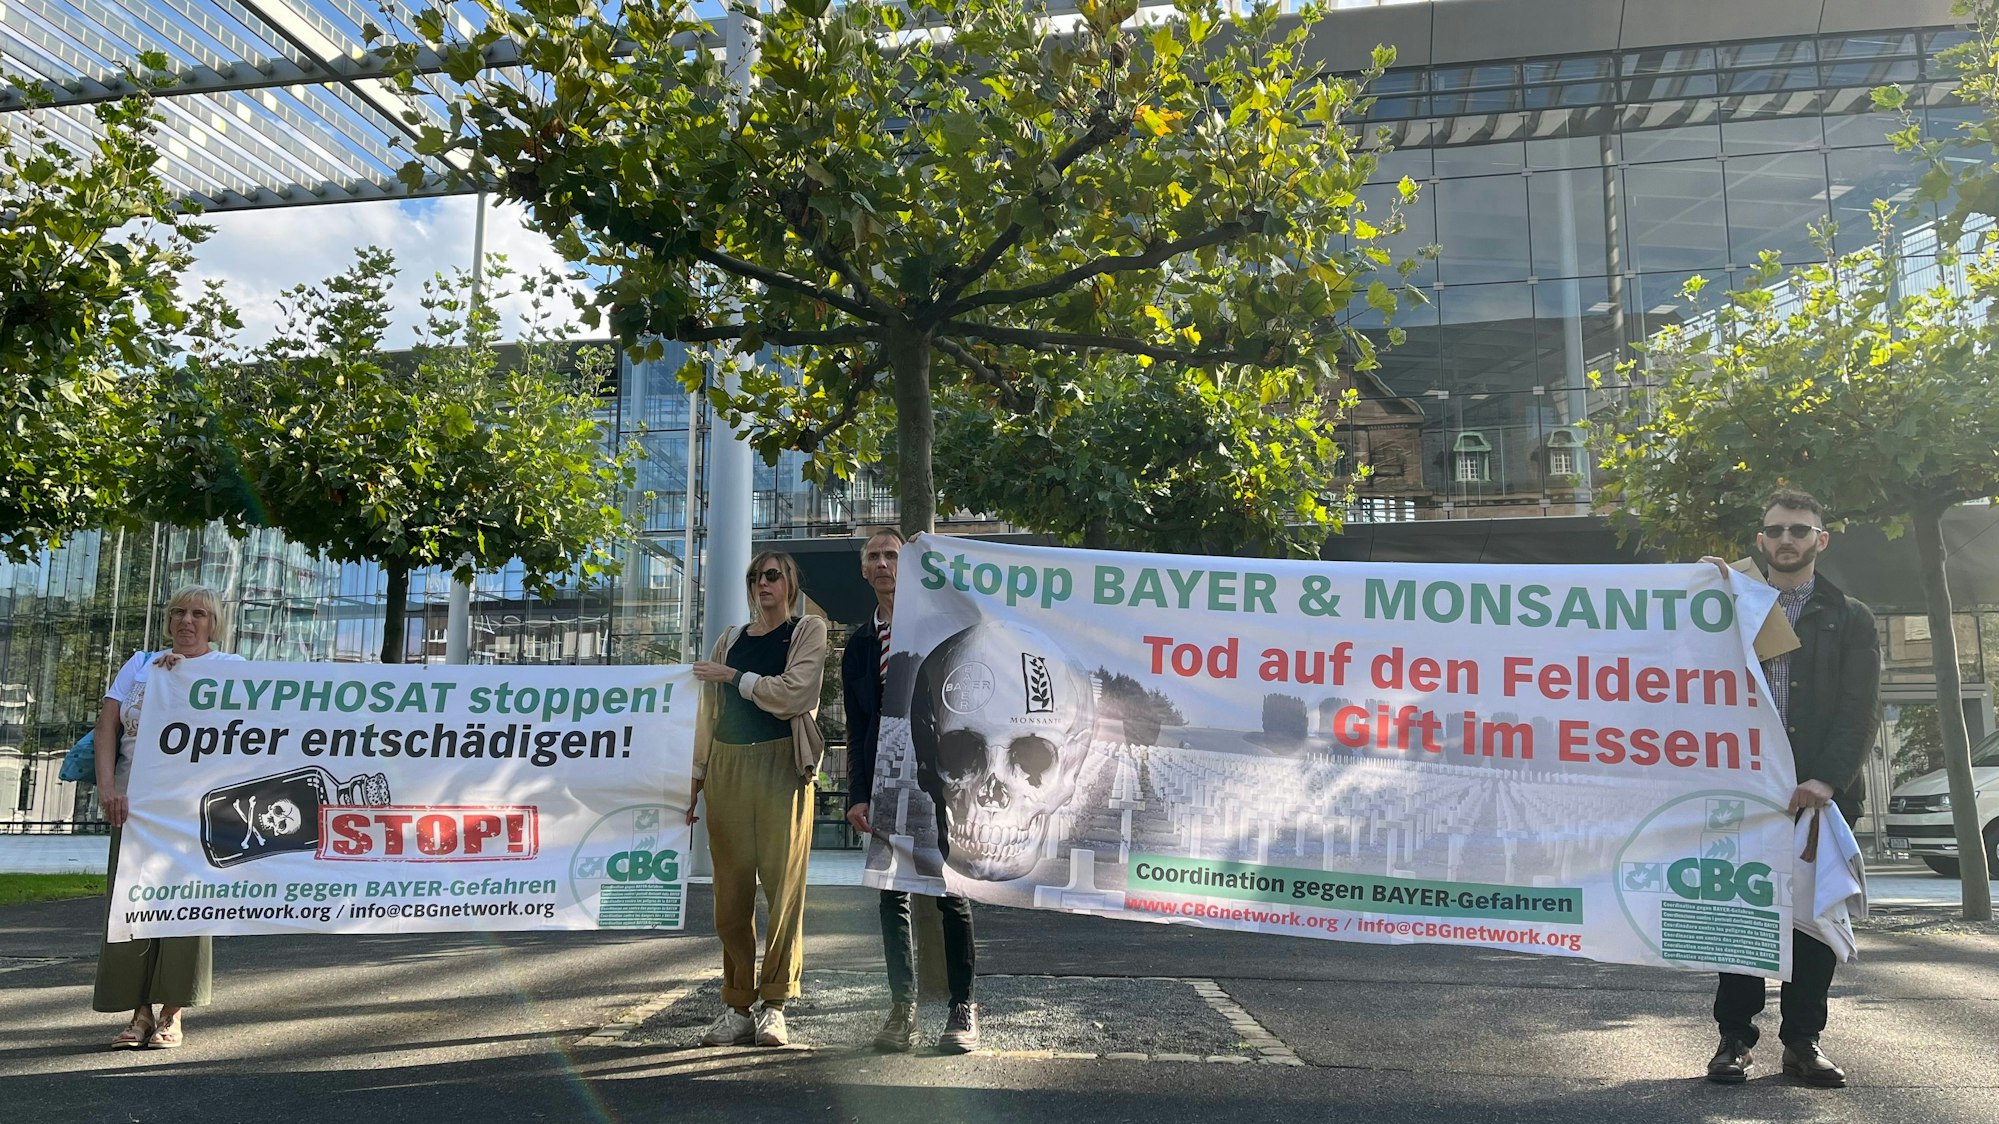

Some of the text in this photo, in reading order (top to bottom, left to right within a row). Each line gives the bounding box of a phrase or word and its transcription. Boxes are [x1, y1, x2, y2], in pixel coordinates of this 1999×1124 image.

[920, 549, 1738, 634] Stopp BAYER & MONSANTO
[1143, 635, 1758, 708] Tod auf den Feldern!
[188, 678, 674, 723] GLYPHOSAT stoppen!
[159, 718, 633, 768] Opfer entschädigen!
[1332, 704, 1761, 770] Gift im Essen!
[330, 814, 526, 858] STOP!
[128, 877, 557, 903] Coordination gegen BAYER-Gefahren
[606, 849, 680, 882] CBG
[1135, 863, 1573, 913] Coordination gegen BAYER-Gefahren
[1666, 857, 1774, 907] CBG
[125, 904, 332, 924] www.CBGnetwork.org
[349, 900, 555, 919] info@CBGnetwork.org
[1125, 897, 1338, 932] www.CBGnetwork.org
[1356, 917, 1582, 951] info@CBGnetwork.org
